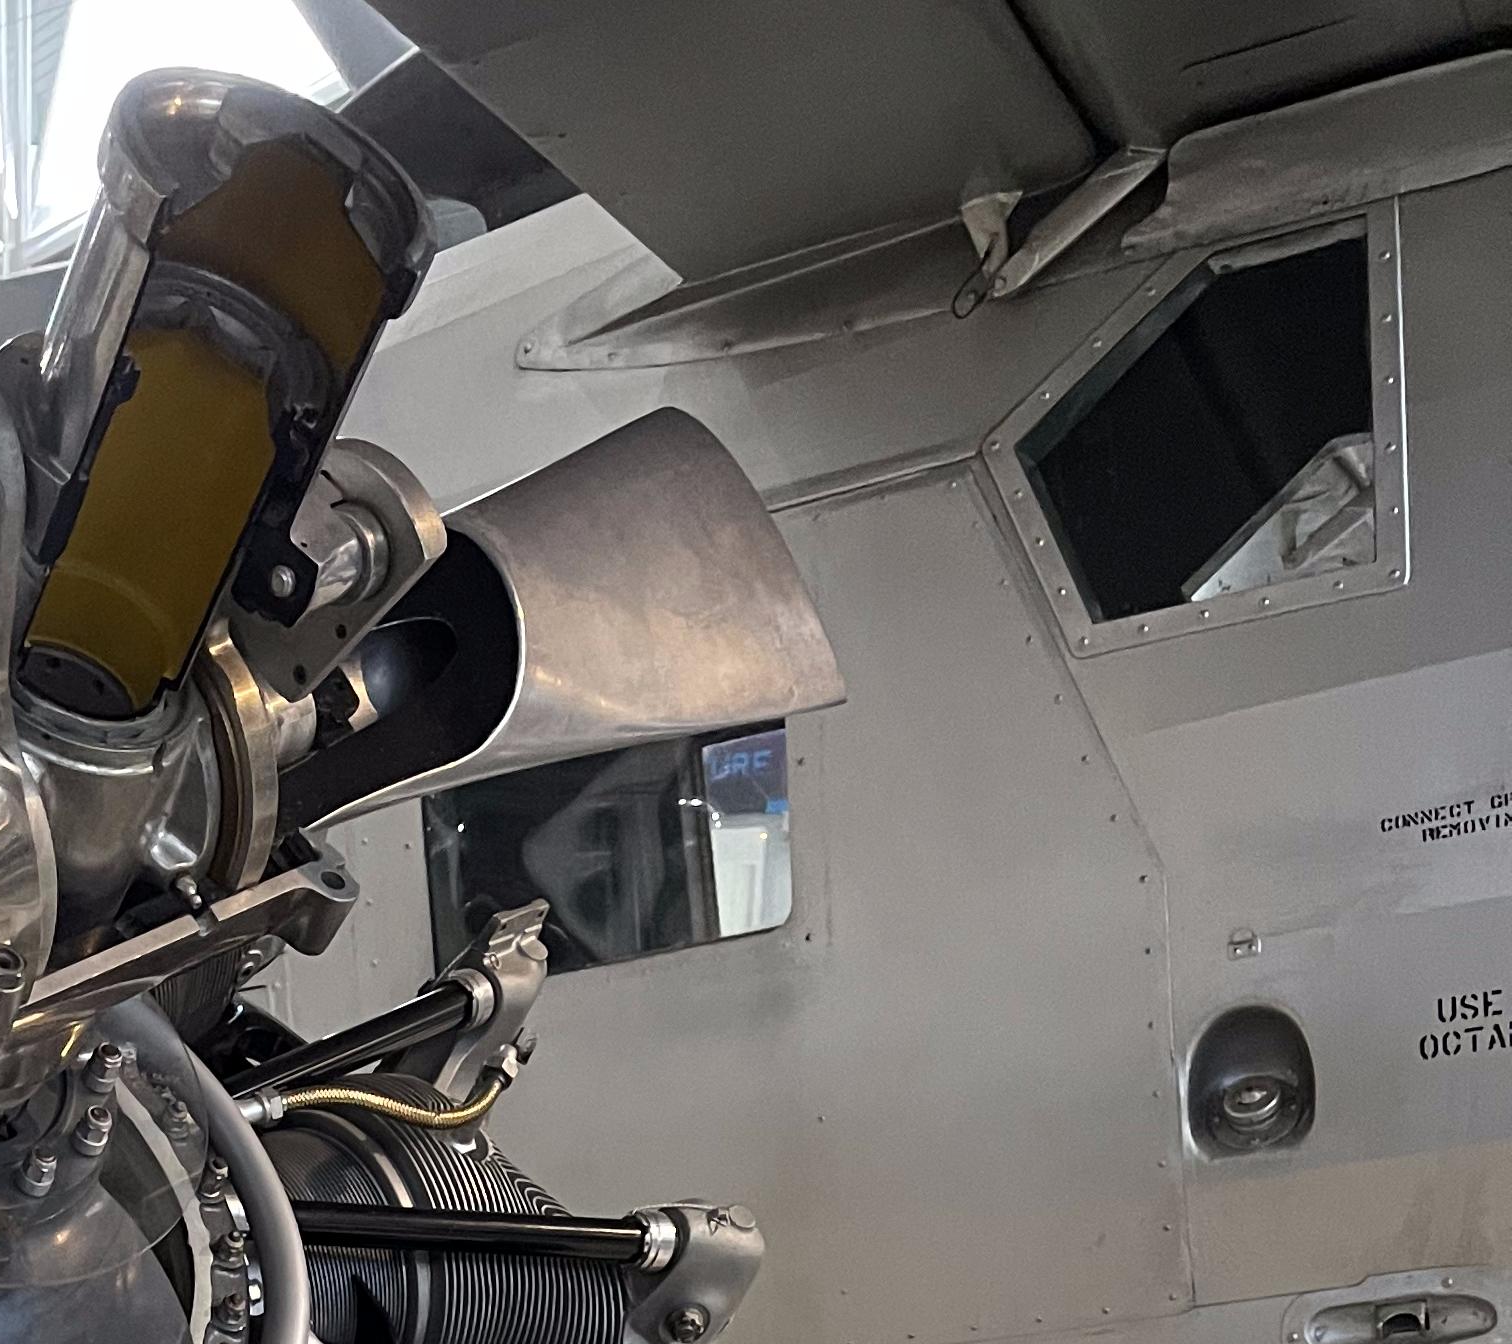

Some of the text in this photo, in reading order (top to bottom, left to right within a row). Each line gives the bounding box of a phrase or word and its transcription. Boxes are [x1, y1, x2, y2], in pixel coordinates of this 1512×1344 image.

[1380, 800, 1475, 832] CONNECT
[1437, 989, 1503, 1023] USE
[1419, 1021, 1512, 1060] OCTA
